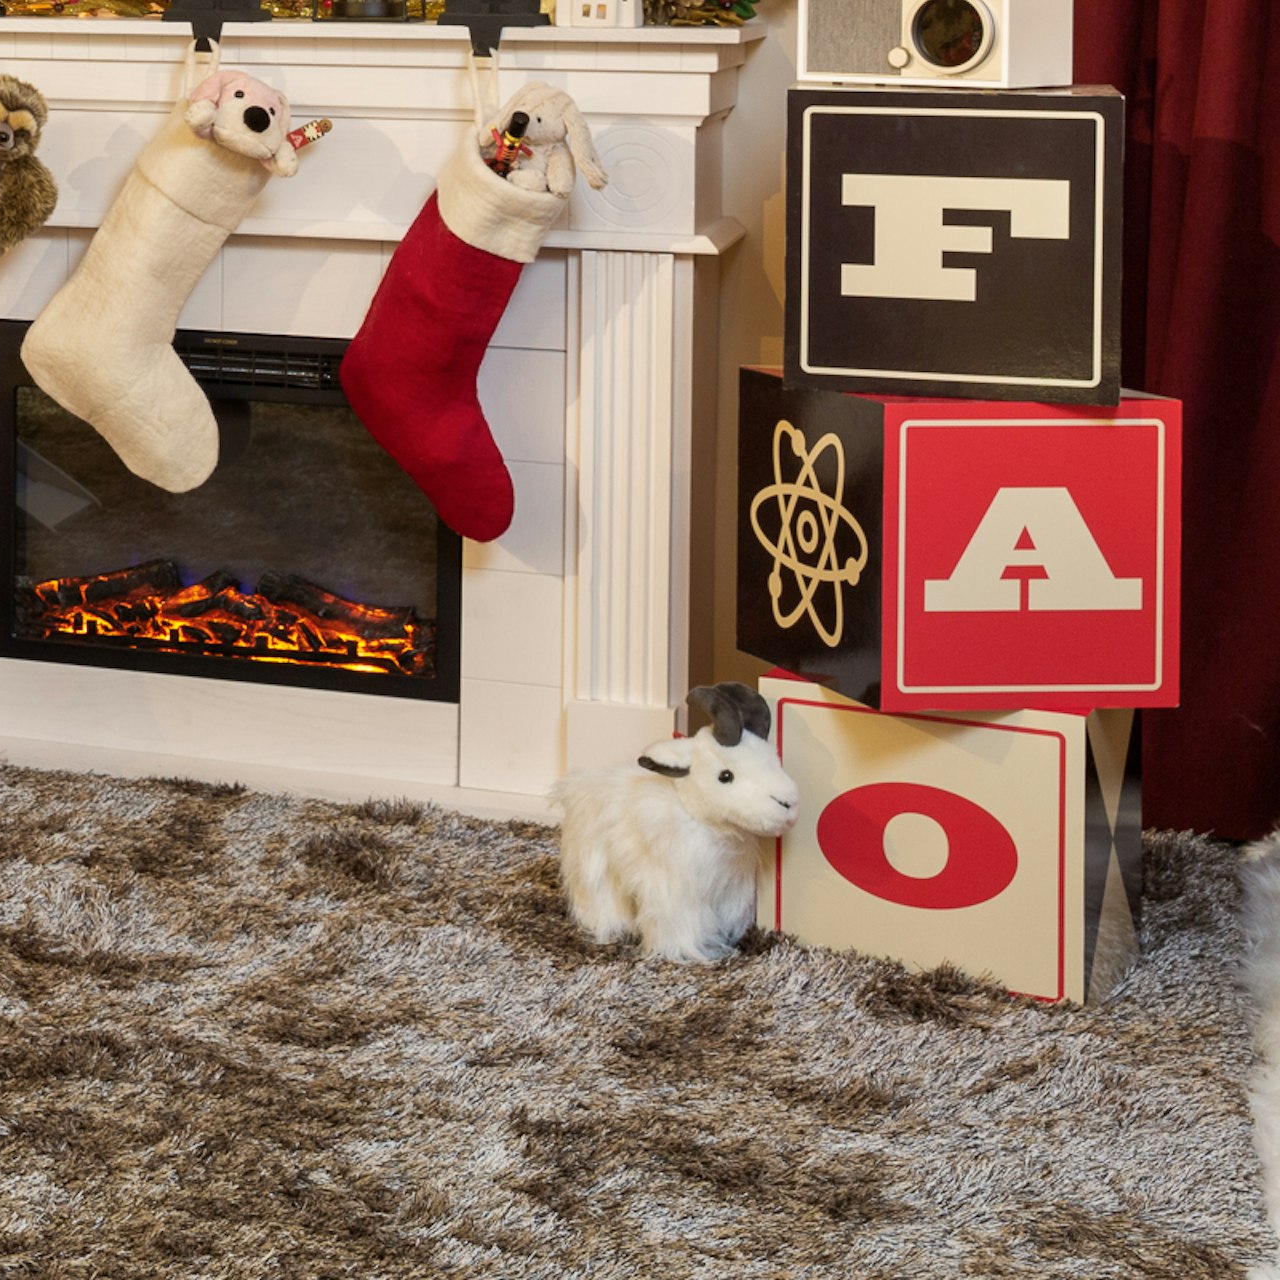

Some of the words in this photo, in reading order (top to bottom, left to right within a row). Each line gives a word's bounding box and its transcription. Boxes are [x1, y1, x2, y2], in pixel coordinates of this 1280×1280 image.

[841, 174, 1070, 301] F
[924, 487, 1143, 612] A
[816, 782, 1018, 910] O
